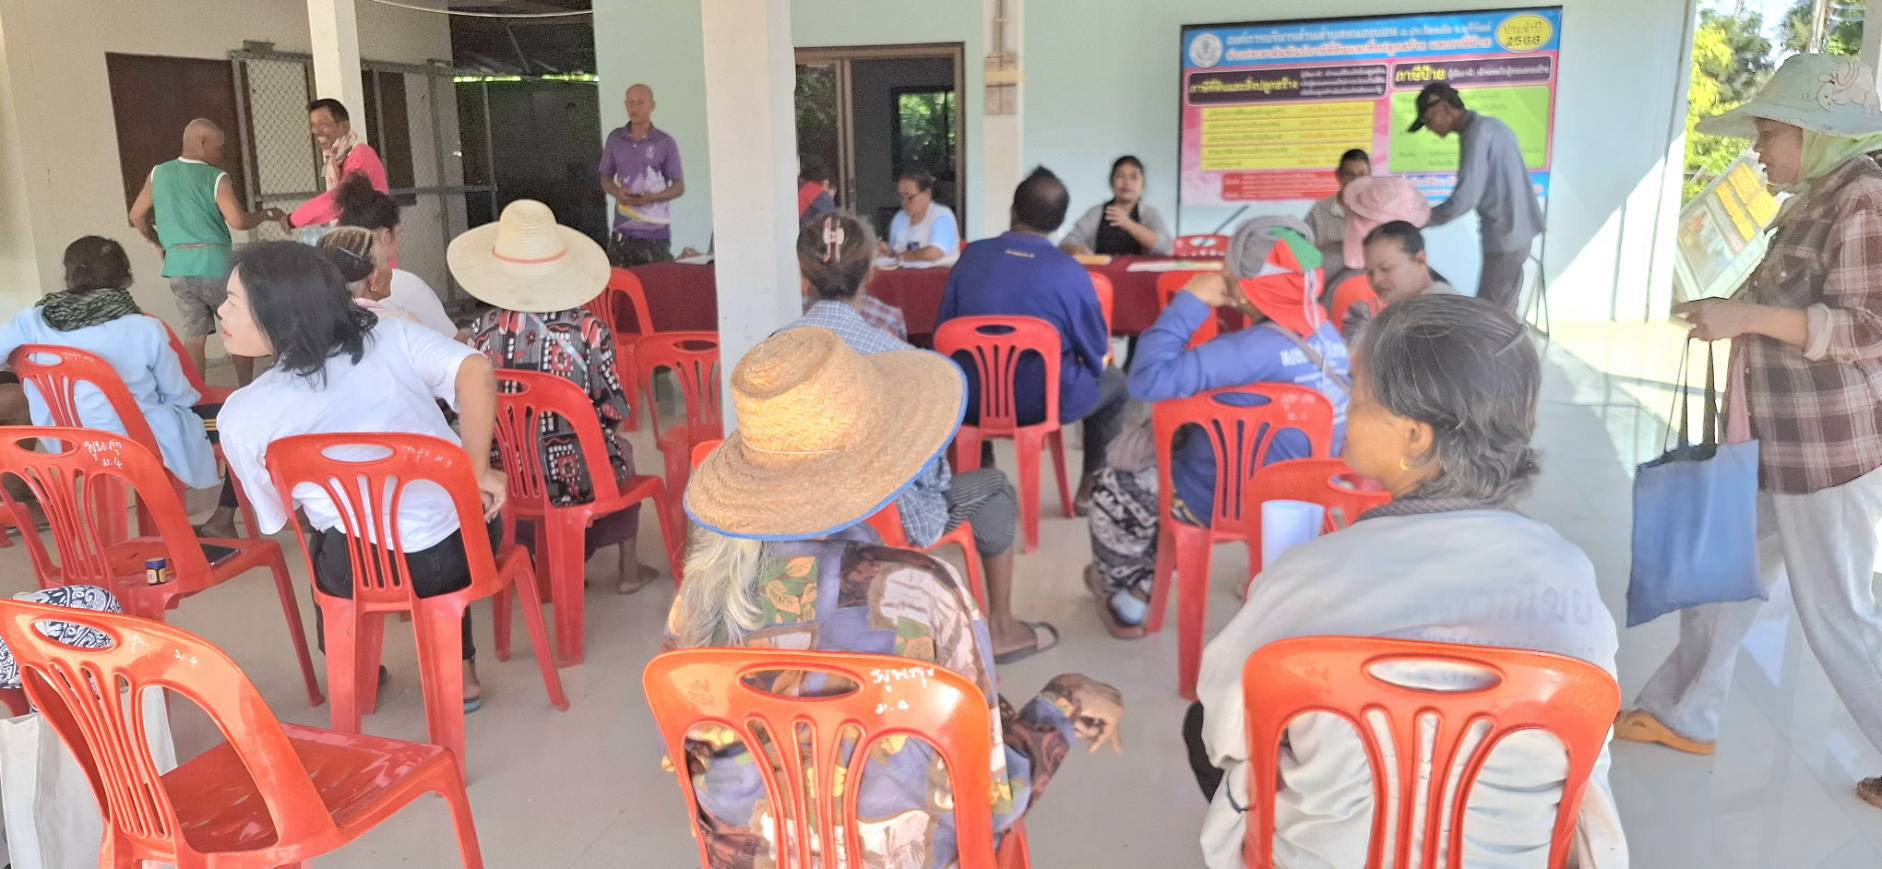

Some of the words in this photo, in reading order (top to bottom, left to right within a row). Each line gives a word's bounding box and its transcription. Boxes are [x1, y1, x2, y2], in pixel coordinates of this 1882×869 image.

[1507, 34, 1541, 47] 2568
[1395, 65, 1447, 82] ภาษีป้าย
